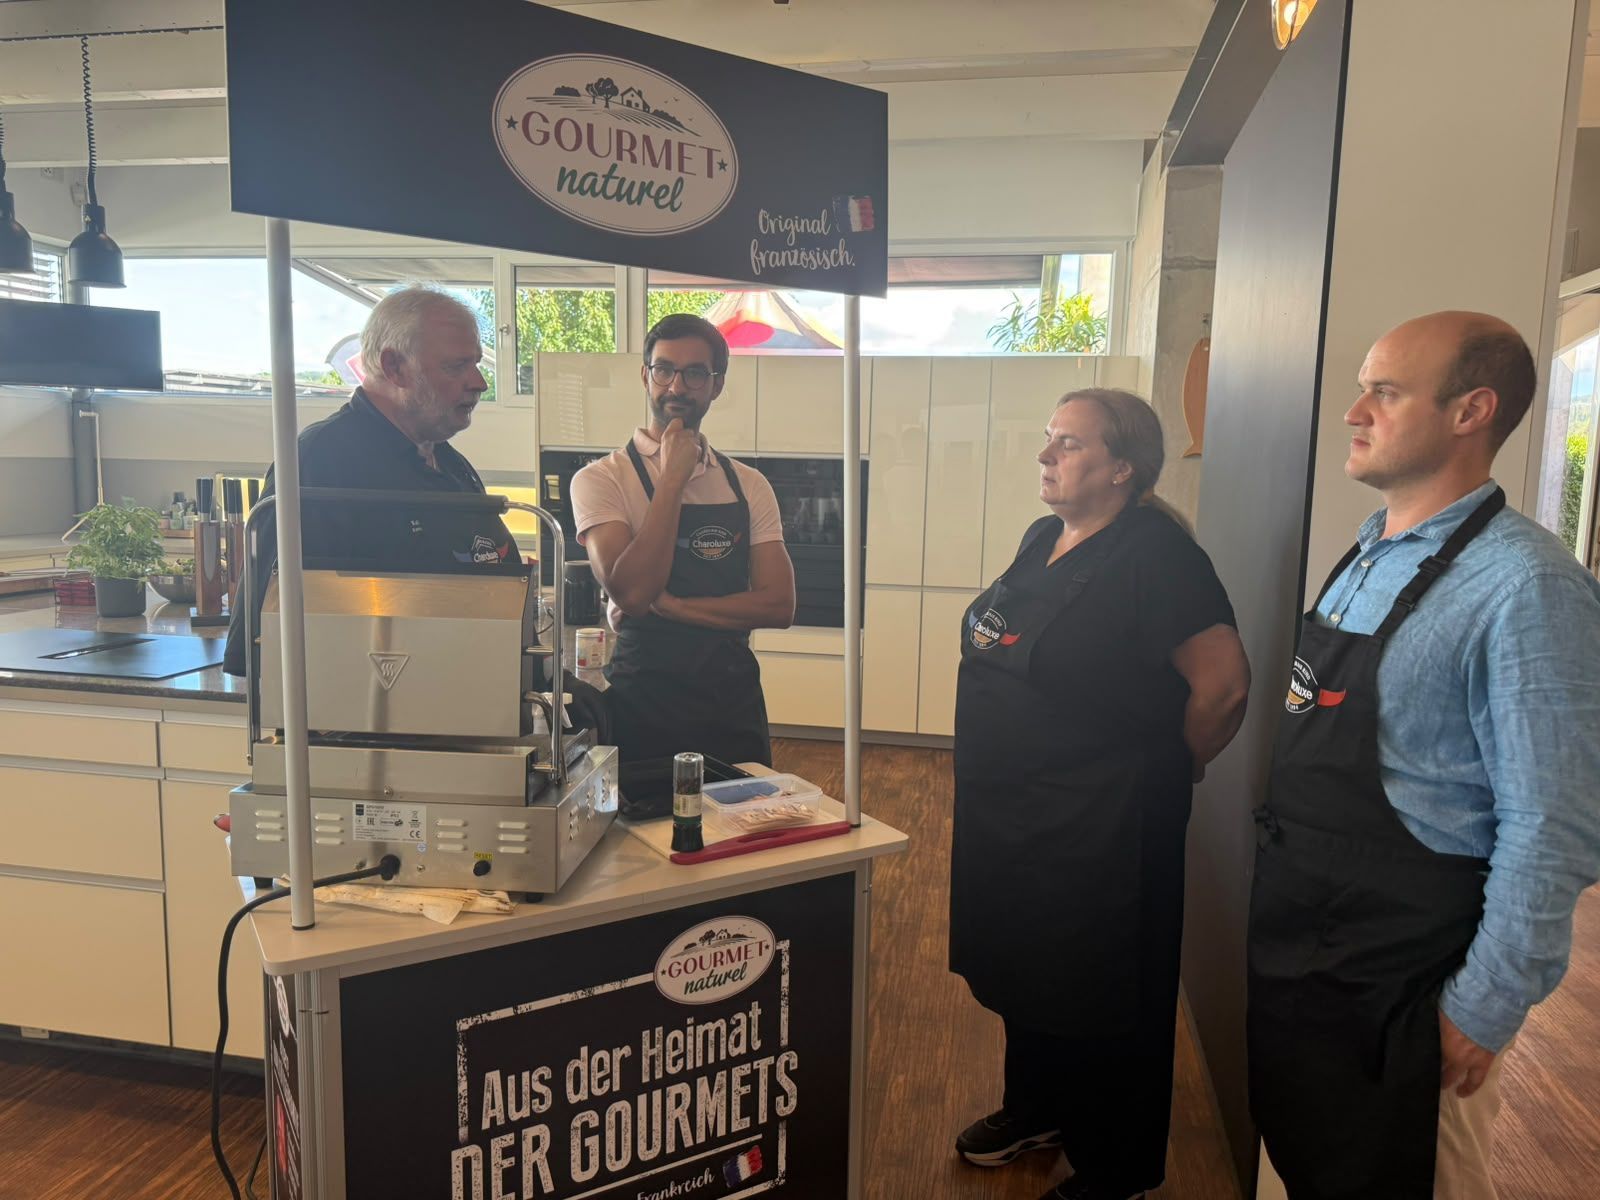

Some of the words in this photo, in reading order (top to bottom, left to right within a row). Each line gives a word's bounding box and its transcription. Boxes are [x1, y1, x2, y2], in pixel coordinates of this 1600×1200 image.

[521, 111, 721, 179] GOURMET
[556, 163, 684, 212] naturel
[758, 208, 831, 246] Original
[750, 238, 855, 275] französisch.
[668, 940, 767, 979] GOURMET
[684, 962, 748, 995] naturel
[481, 1066, 552, 1130] Aus
[566, 1046, 632, 1104] der
[642, 1001, 762, 1083] Heimat
[451, 1124, 555, 1200] DER
[570, 1050, 798, 1184] GOURMETS
